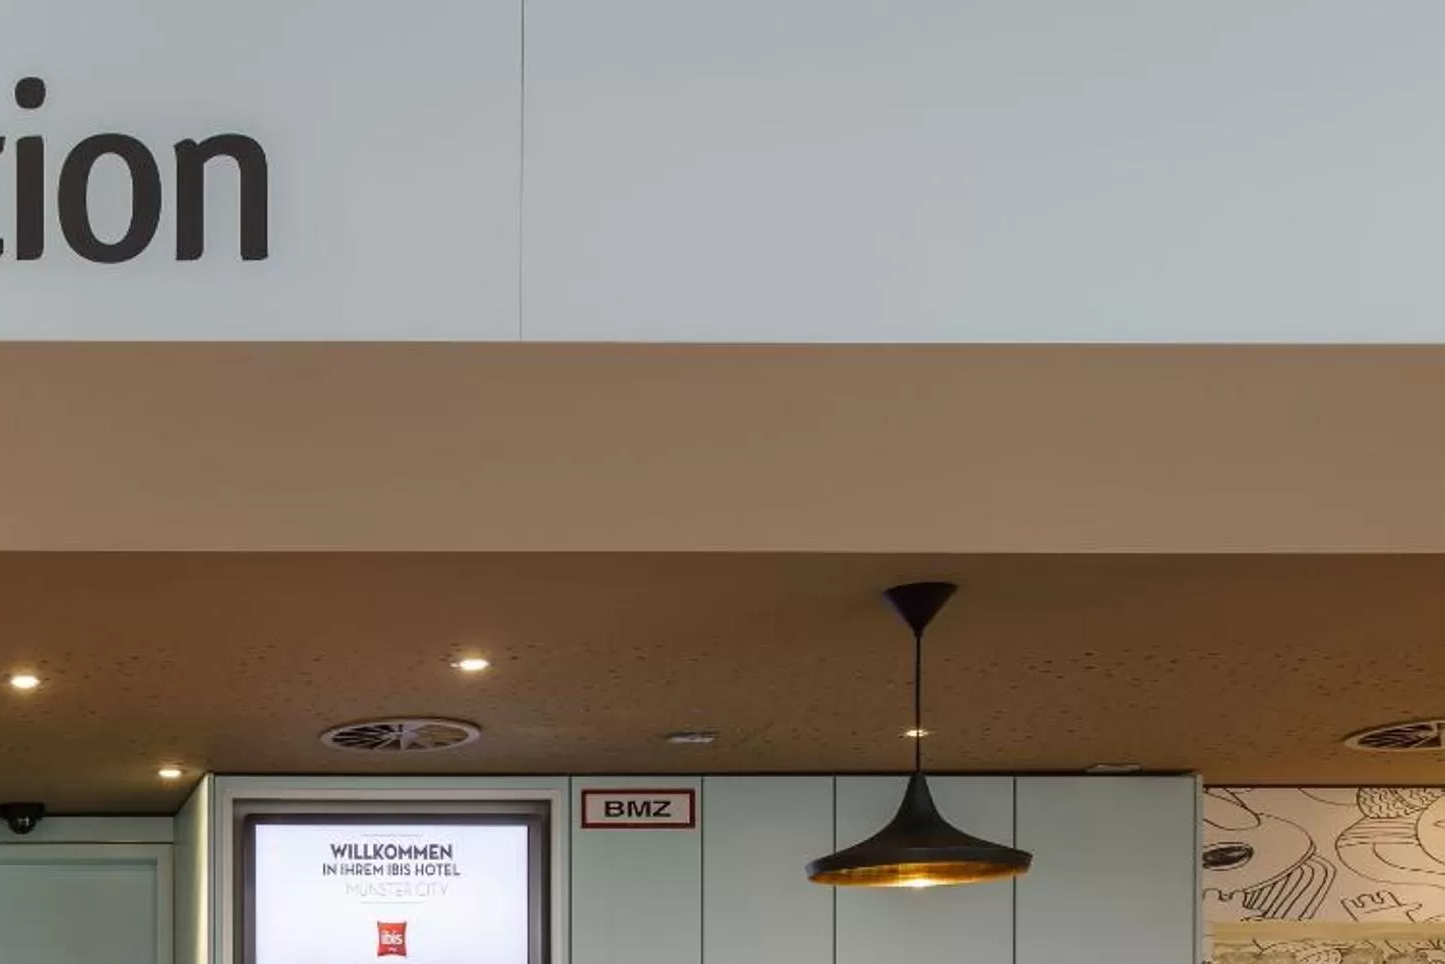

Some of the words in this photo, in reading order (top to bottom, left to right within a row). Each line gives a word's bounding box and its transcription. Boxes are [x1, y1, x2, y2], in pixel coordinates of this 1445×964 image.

[604, 800, 671, 817] BMZ
[330, 843, 452, 860] WILLKOMMEN
[322, 863, 337, 876] IN
[340, 863, 383, 876] IHREM
[387, 863, 411, 876] IBIS
[415, 863, 460, 876] HOTEL
